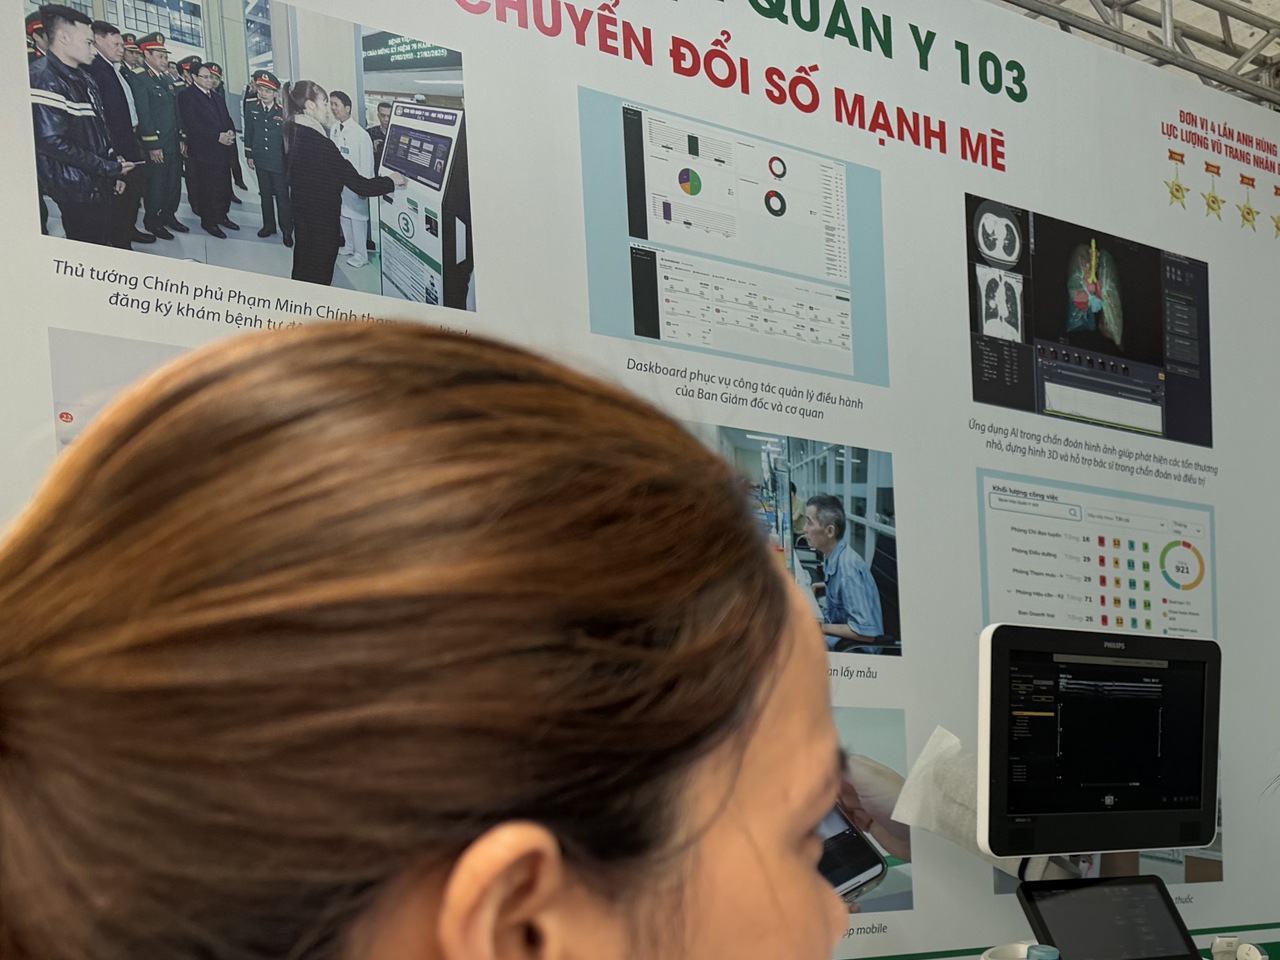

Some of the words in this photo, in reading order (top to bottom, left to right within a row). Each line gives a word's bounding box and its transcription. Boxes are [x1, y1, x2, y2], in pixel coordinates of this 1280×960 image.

[908, 23, 937, 72] Y
[954, 39, 1028, 103] 103
[669, 30, 750, 95] ĐỔI
[764, 64, 820, 114] SỐ
[834, 87, 947, 154] MẠNH
[960, 127, 1006, 172] MẼ
[1161, 122, 1178, 138] LỰC
[1180, 128, 1209, 149] LƯỢNG
[1210, 139, 1222, 154] VŨ
[1223, 144, 1251, 164] TRANG
[1252, 155, 1276, 173] NHÂN
[1179, 110, 1197, 127] ĐƠN
[1199, 117, 1208, 132] VỊ
[1209, 121, 1216, 134] 4
[1235, 131, 1253, 147] ANH
[1255, 138, 1277, 156] HÙNG
[52, 258, 84, 278] Thủ
[89, 266, 138, 290] tướng
[142, 275, 189, 295] Chính
[192, 284, 223, 301] phủ
[227, 289, 270, 309] Phạm
[274, 297, 312, 316] Minh
[315, 305, 357, 322] Chính
[108, 292, 150, 313] đăng
[154, 299, 173, 317] ký
[176, 303, 220, 322] khám
[225, 311, 262, 328] bệnh
[626, 357, 687, 379] Daskboard
[688, 369, 716, 385] phục
[717, 376, 731, 388] vụ
[732, 377, 758, 393] công
[760, 381, 776, 394] tác
[805, 388, 815, 403] lý
[838, 394, 863, 409] hành
[675, 386, 695, 398] của
[696, 387, 717, 402] Ban
[719, 391, 748, 406] Giám
[770, 400, 783, 412] và
[784, 405, 797, 414] cơ
[798, 407, 824, 419] quan
[1174, 564, 1190, 575] 921
[856, 924, 888, 935] mobile
